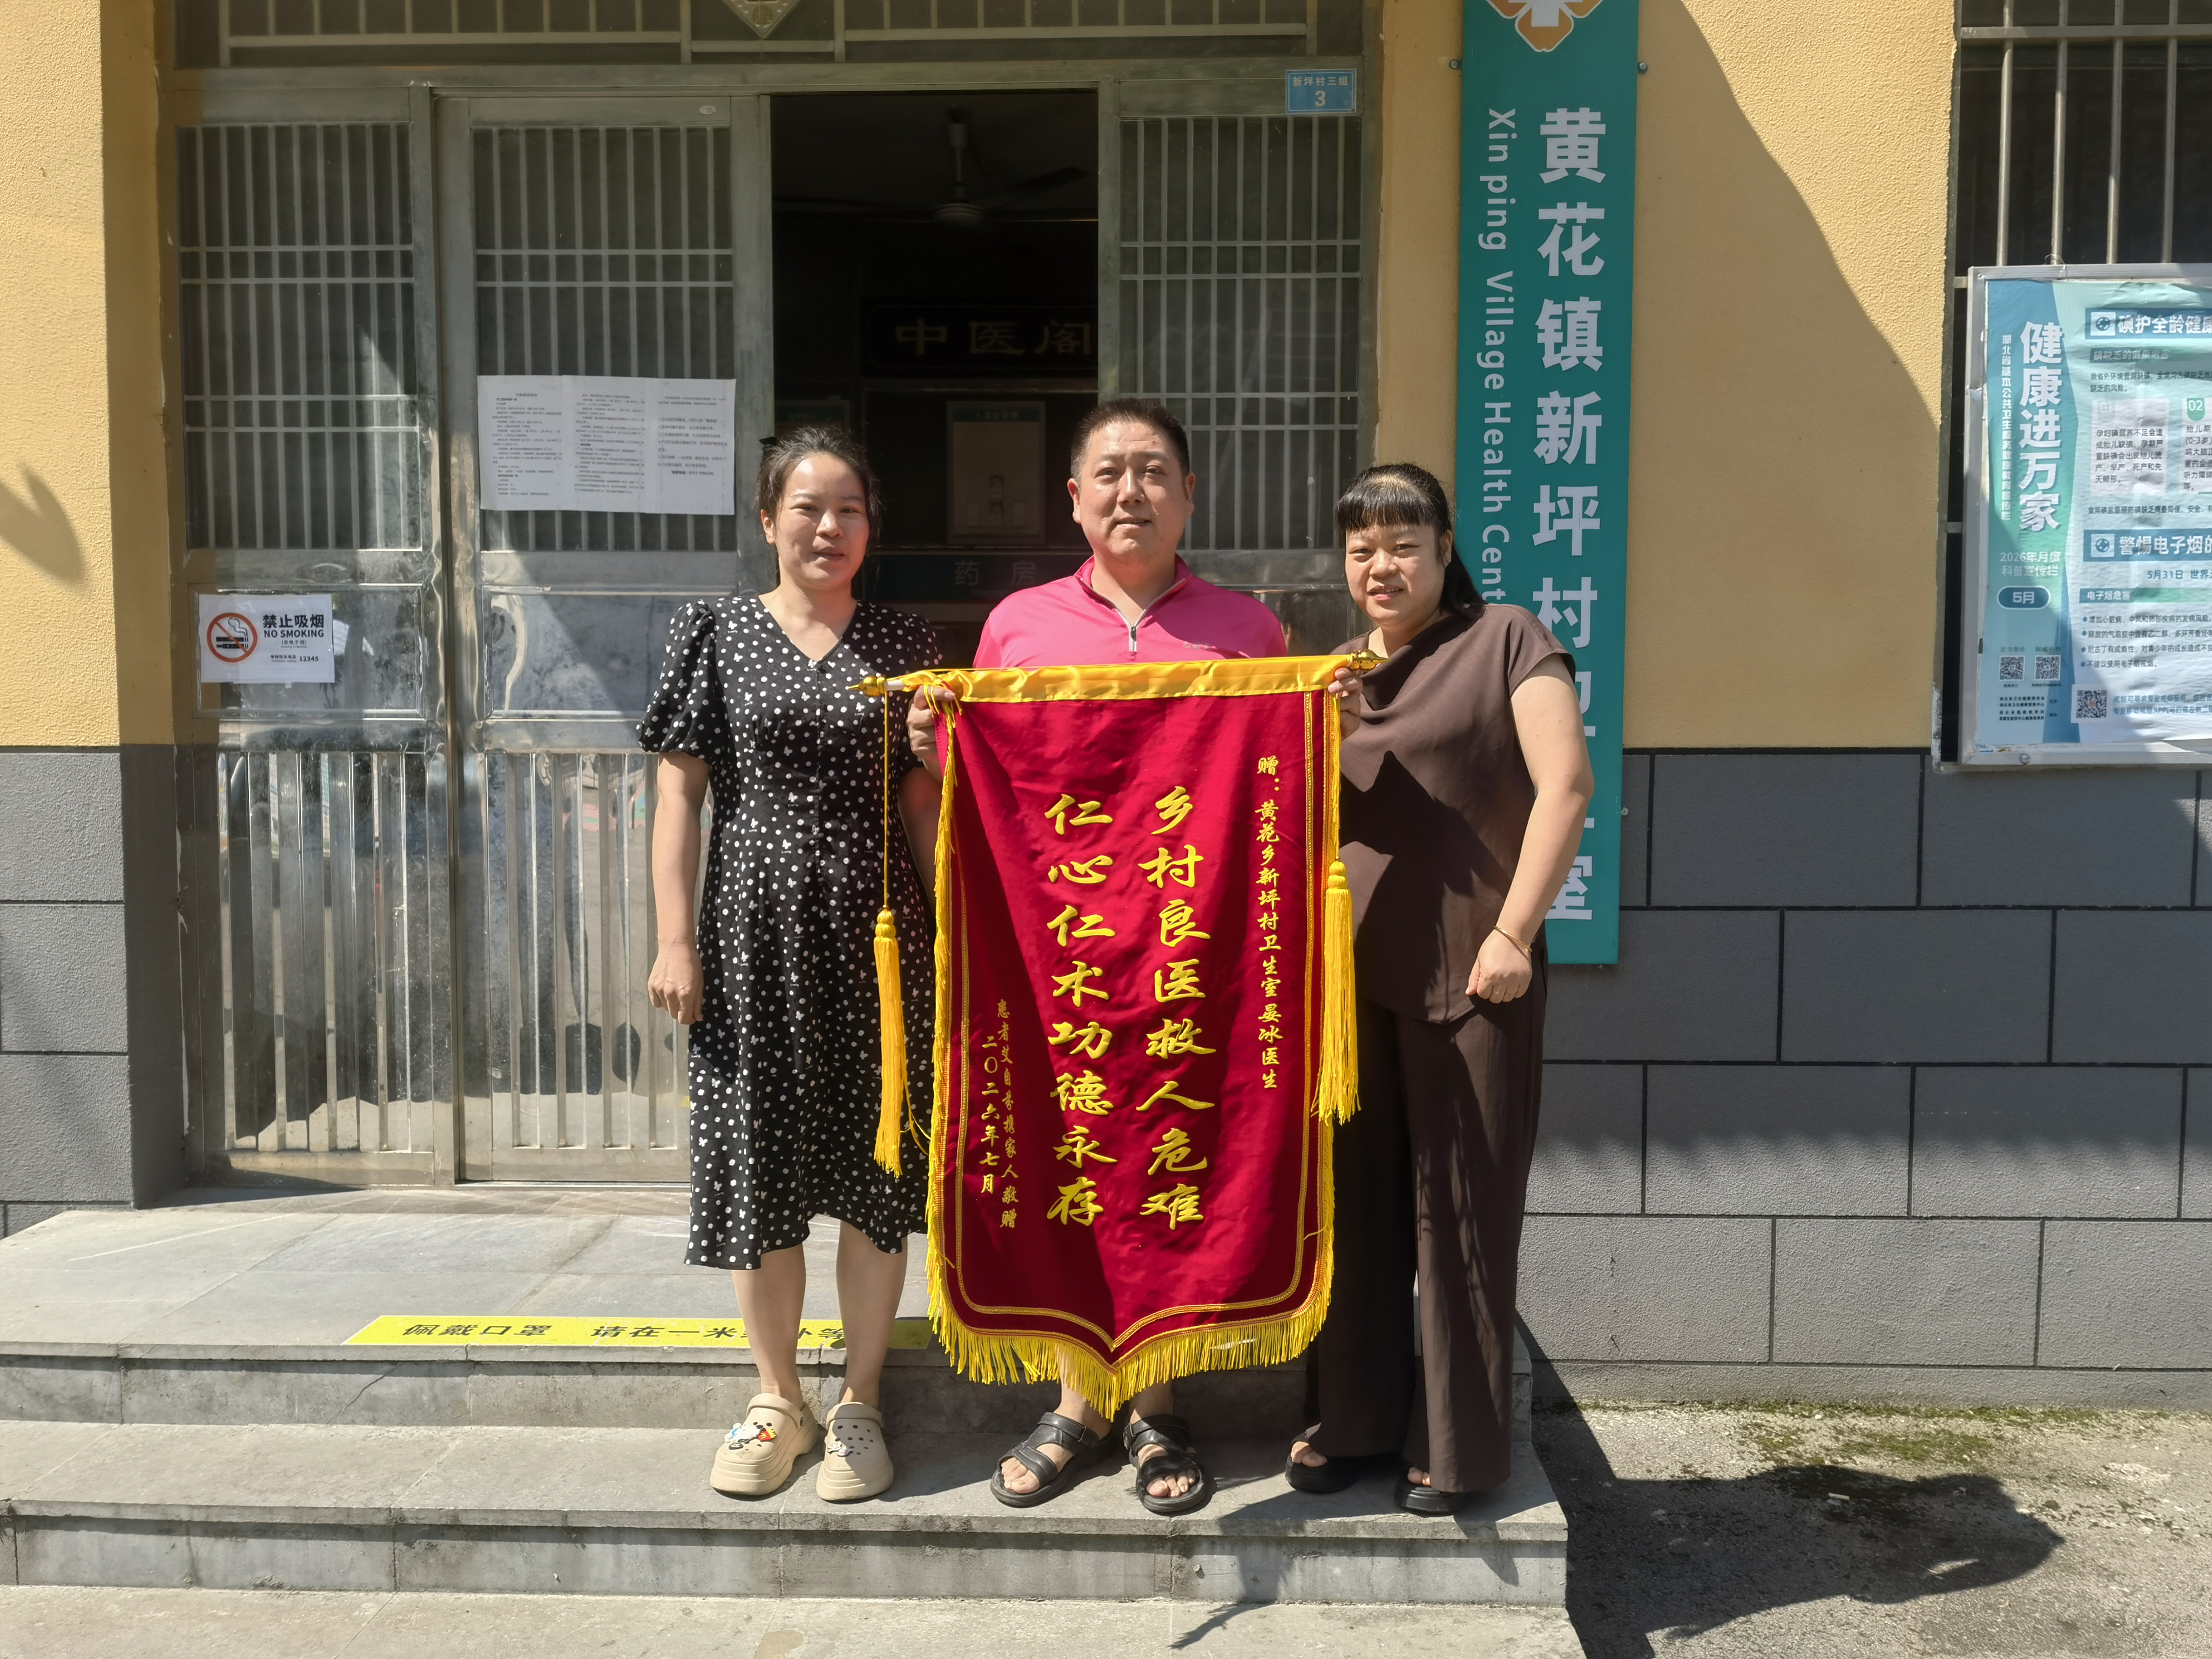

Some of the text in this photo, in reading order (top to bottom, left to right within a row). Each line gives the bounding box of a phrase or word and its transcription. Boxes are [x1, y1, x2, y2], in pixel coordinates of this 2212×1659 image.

[1293, 76, 1348, 86] 新坪村三组
[1314, 90, 1326, 107] 3
[894, 318, 1091, 355] 中医阁
[1476, 108, 1518, 601] Xin ping Village Health Cent
[2188, 400, 2204, 412] 02
[2019, 321, 2063, 531] 健康进万家
[1532, 107, 1606, 920] 黄花镇新坪村室
[2000, 551, 2062, 562] 2026年月度
[954, 559, 1037, 586] 药房
[2001, 564, 2059, 576] 科普宣传栏
[2147, 569, 2212, 579] 5月31日 世界
[2013, 591, 2035, 604] 5月
[2087, 591, 2130, 601] 电子烟危害
[262, 614, 325, 629] 禁止吸烟
[264, 629, 325, 638] NO SMOKING
[1044, 793, 1118, 1226] 仁心仁术功德永存
[1136, 786, 1217, 1231] 乡村良医救人危难
[401, 1324, 553, 1337] 佩戴口罩
